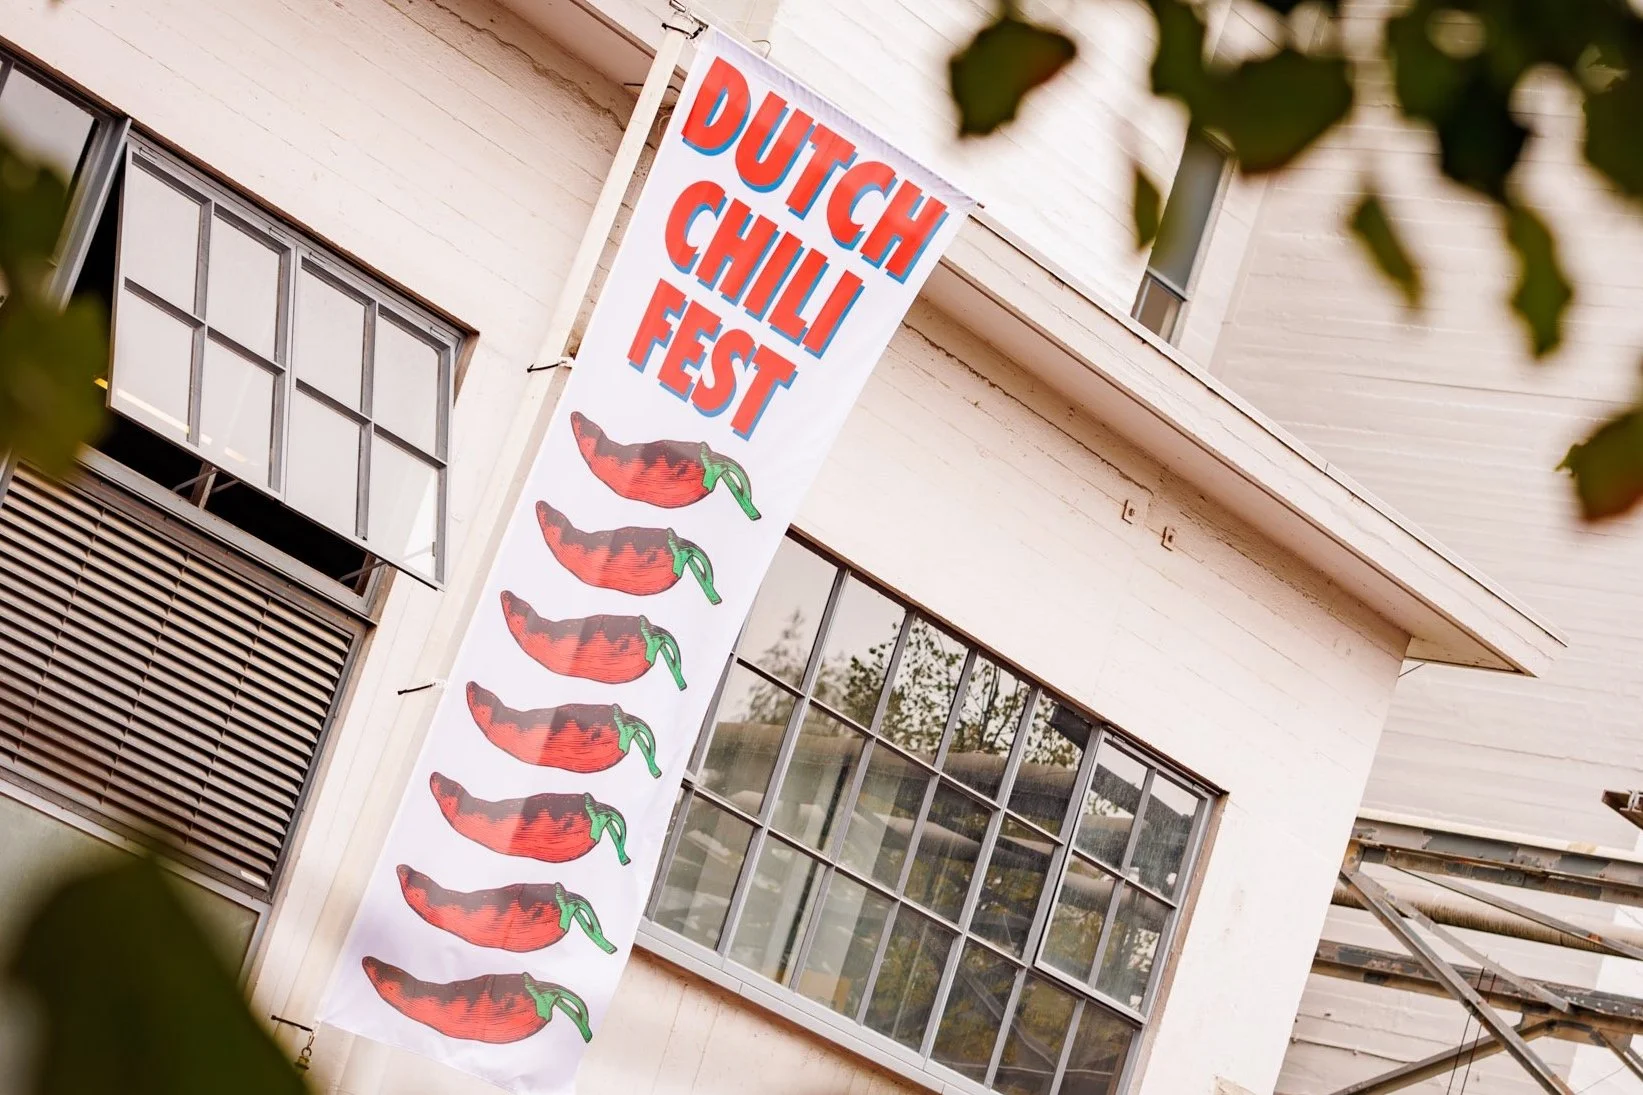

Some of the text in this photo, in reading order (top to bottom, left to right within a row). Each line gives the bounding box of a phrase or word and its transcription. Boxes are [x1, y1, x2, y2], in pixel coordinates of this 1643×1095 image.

[681, 56, 949, 284] DUTCH
[627, 278, 798, 441] FEST
[665, 180, 865, 360] CHILI
